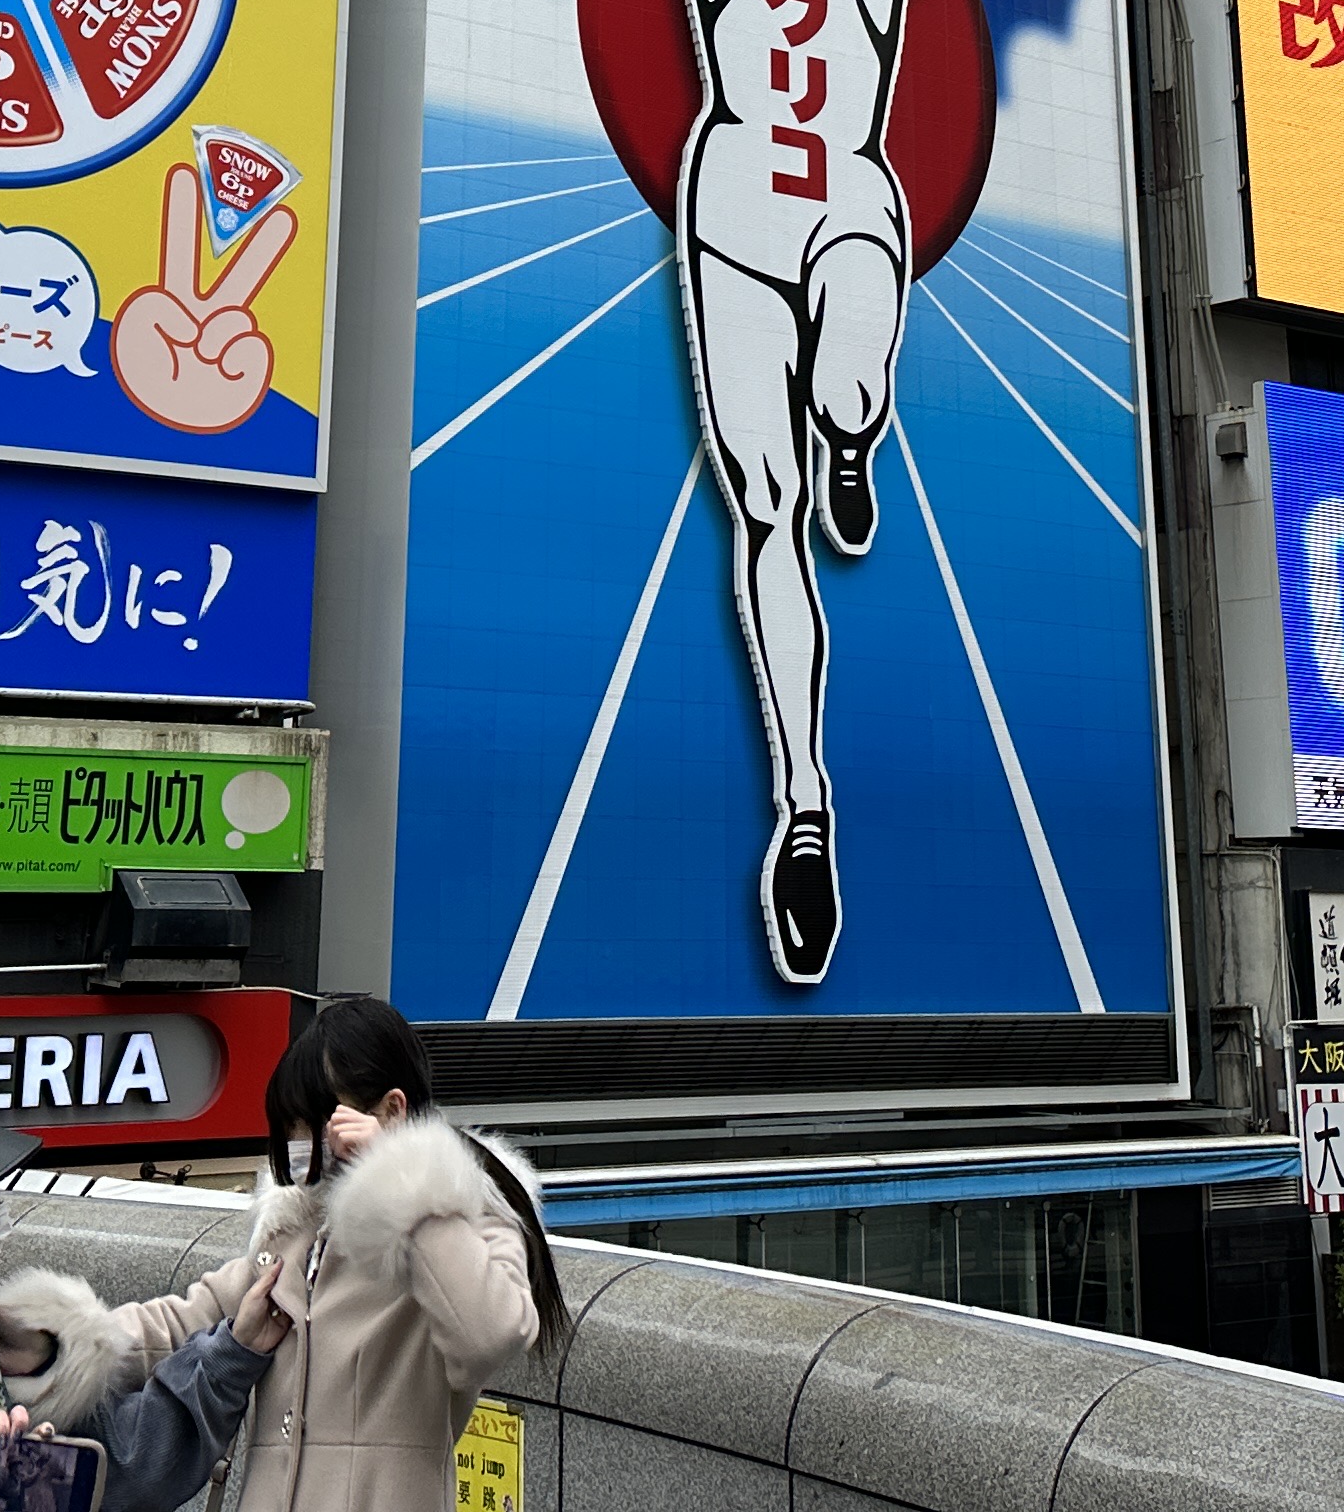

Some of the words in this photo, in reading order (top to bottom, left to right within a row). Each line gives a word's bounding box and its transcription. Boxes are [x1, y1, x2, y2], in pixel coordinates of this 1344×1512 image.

[107, 5, 144, 50] BRAND
[216, 145, 273, 182] SNOW
[216, 188, 250, 211] CHEESE
[59, 766, 206, 847] ピタットハウス
[457, 1452, 475, 1470] not
[481, 1452, 506, 1480] jump
